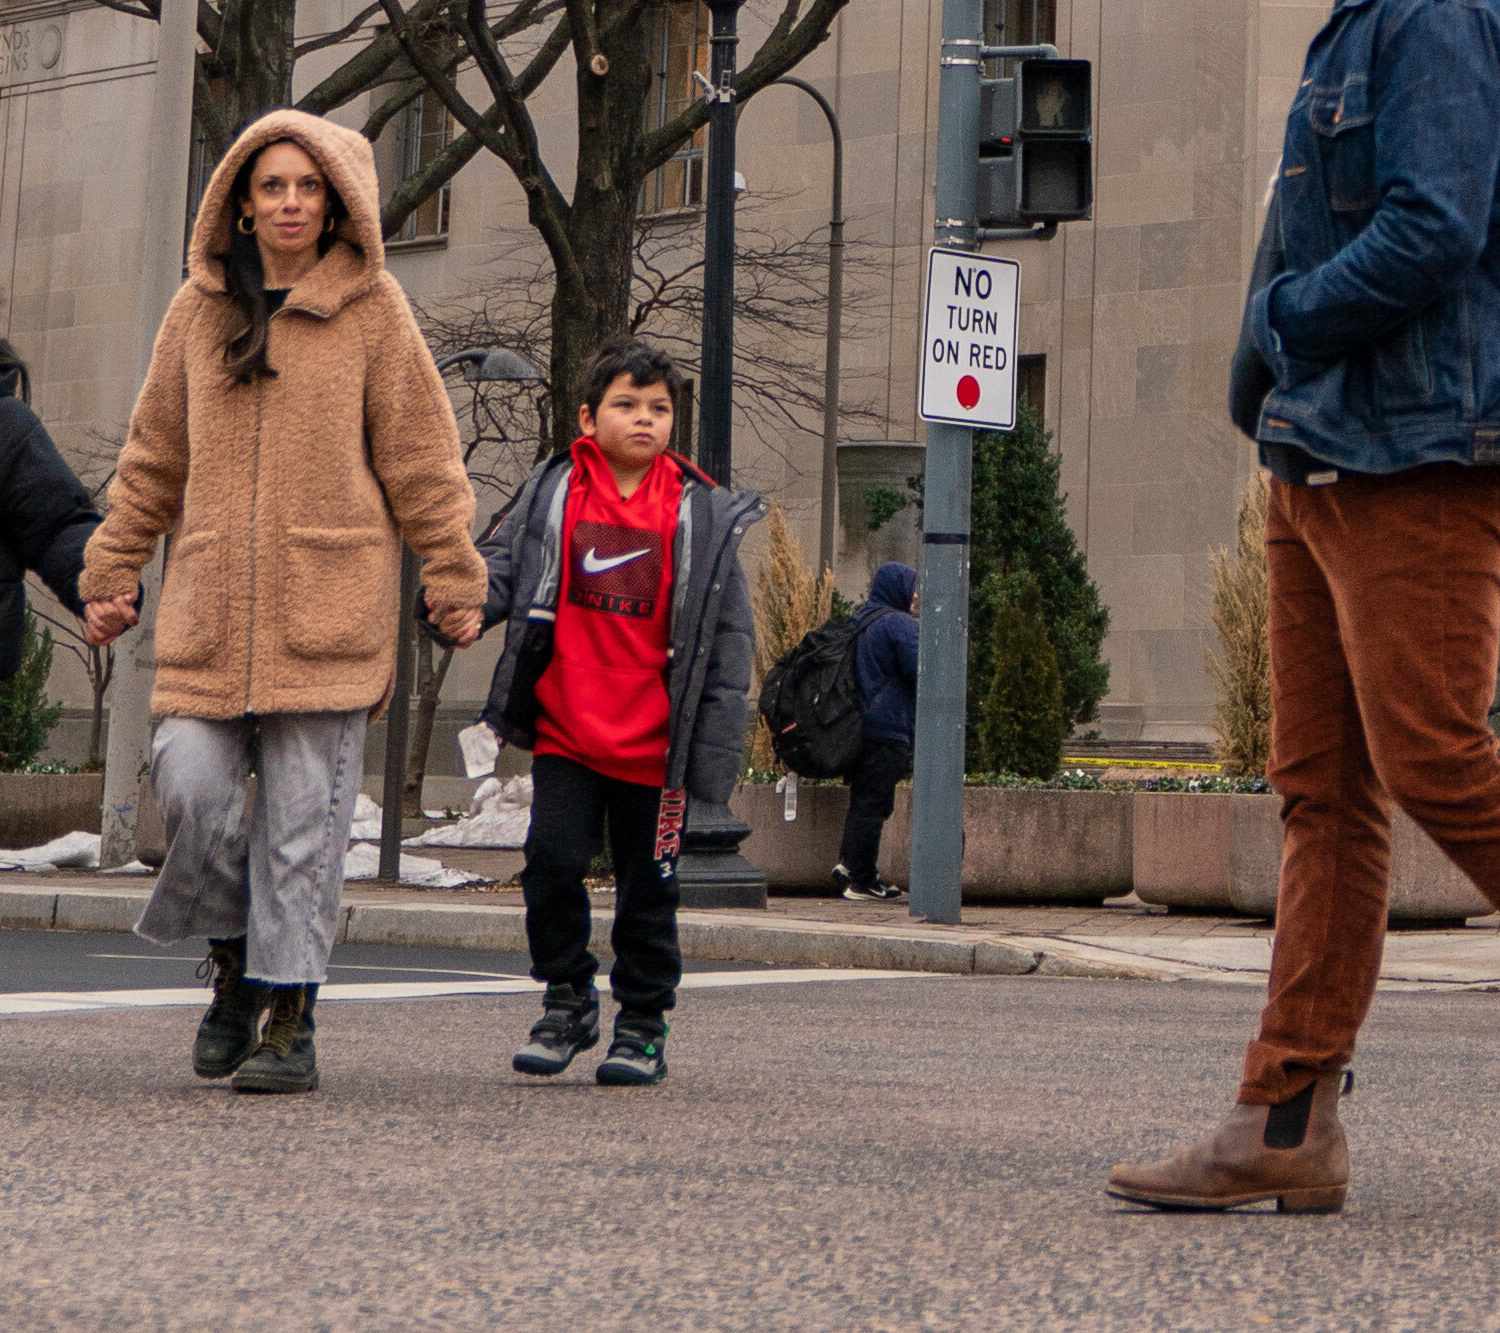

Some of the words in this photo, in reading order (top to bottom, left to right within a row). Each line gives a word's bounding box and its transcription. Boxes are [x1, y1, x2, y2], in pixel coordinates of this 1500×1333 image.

[954, 266, 992, 300] NO
[947, 305, 998, 335] TURN
[932, 339, 959, 365] ON
[969, 343, 1007, 371] RED
